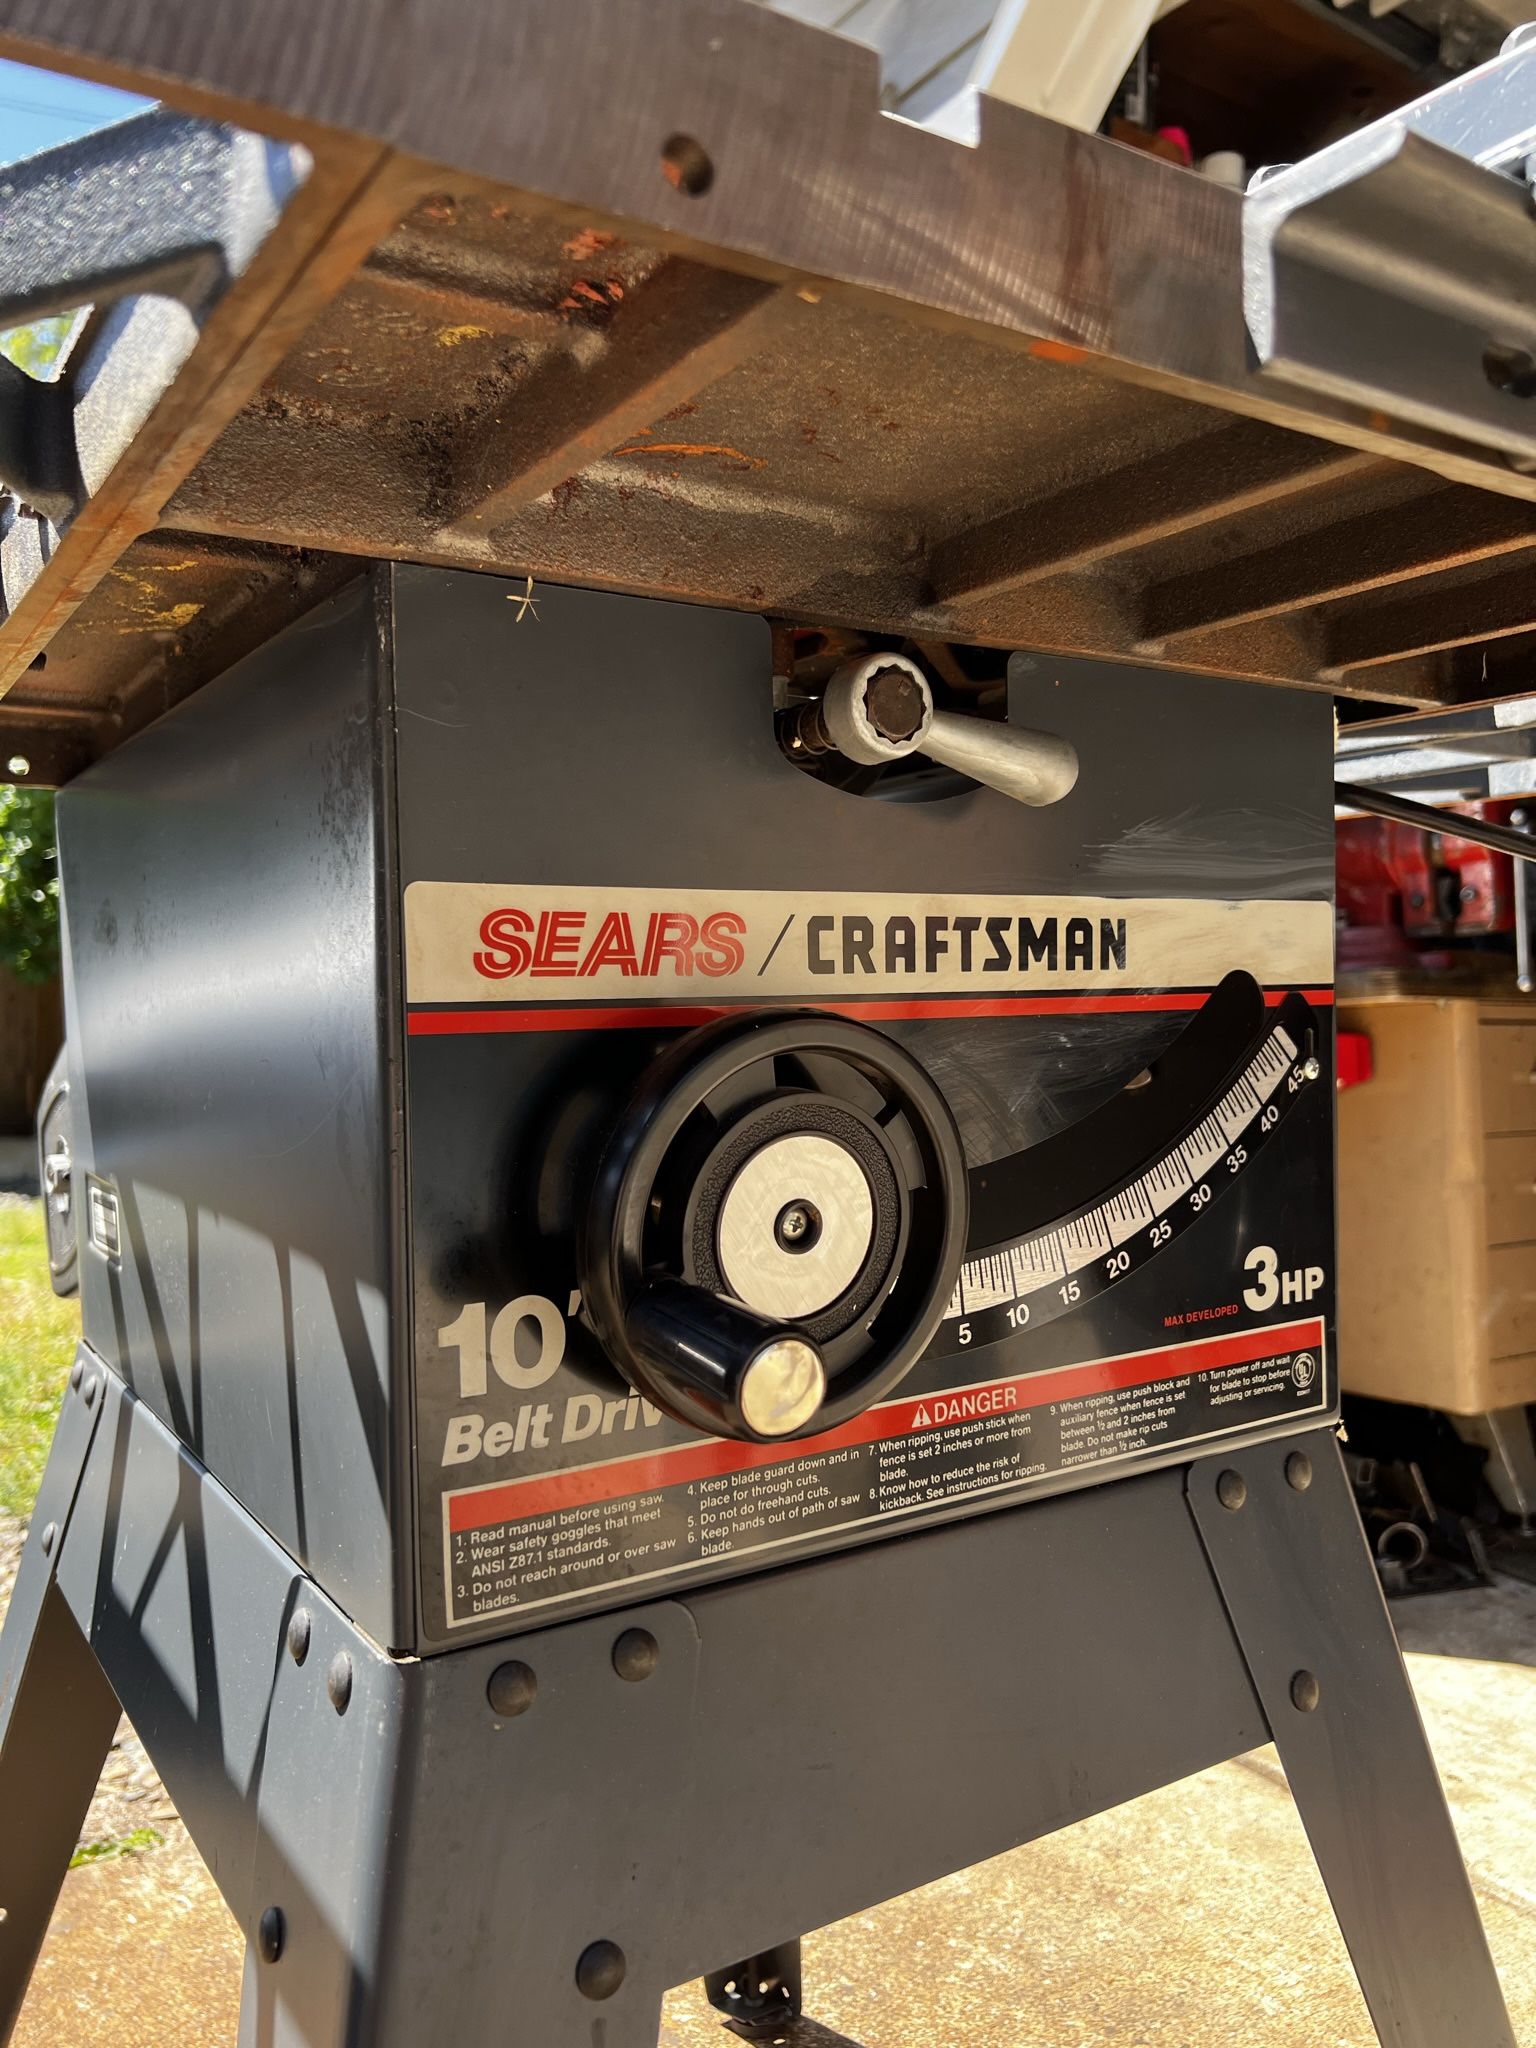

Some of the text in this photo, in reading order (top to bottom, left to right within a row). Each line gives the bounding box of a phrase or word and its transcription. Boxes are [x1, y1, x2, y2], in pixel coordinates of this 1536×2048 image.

[473, 908, 747, 980] SEARS
[807, 916, 1127, 974] CRAFTSMAN
[958, 1066, 1305, 1345] 5 10 15 20 25 30 35 40 45
[1243, 1246, 1324, 1312] 3 HP
[1164, 1304, 1238, 1327] MAX DEVELOPED
[1198, 1356, 1290, 1382] 10. Turn power off and wait
[1210, 1368, 1290, 1393] for blade to stop before
[934, 1386, 1017, 1422] DANGER
[1050, 1376, 1190, 1416] 9. When ripping, use push block and
[1060, 1391, 1186, 1426] auxiliary fence when fence is set
[1210, 1392, 1242, 1406] adjusting
[1244, 1388, 1252, 1397] or
[1254, 1382, 1285, 1395] servicing.
[441, 1386, 663, 1467] Belt Driv
[868, 1412, 1031, 1456] 7. When ripping, use push stick when
[1060, 1426, 1095, 1440] between
[1106, 1418, 1122, 1428] and
[1124, 1416, 1129, 1425] 2
[1130, 1410, 1156, 1423] inches
[1158, 1406, 1176, 1417] from
[1061, 1421, 1168, 1452] blade. Do not make rip cuts
[879, 1426, 1031, 1467] fence is set 2 inches or more from
[1062, 1451, 1097, 1466] narrower
[1100, 1444, 1117, 1456] than
[1129, 1438, 1146, 1449] inch.
[688, 1449, 859, 1495] 4. Keep blade guard down and in
[869, 1453, 1021, 1499] 8. Know how to reduce the risk of
[879, 1467, 908, 1482] blade.
[879, 1462, 1047, 1511] kickback. See instructions for ripping.
[688, 1487, 831, 1527] 5. Do not do freehand cuts.
[700, 1474, 820, 1511] place for through cuts.
[456, 1535, 467, 1547] 1.
[471, 1529, 504, 1544] Read
[509, 1516, 556, 1537] manual
[560, 1508, 600, 1526] before
[604, 1498, 636, 1515] using
[456, 1508, 661, 1564] 2. Wear safety goggles that meet
[688, 1494, 860, 1543] 6. Keep hands out of path of saw
[457, 1538, 677, 1598] 3. Do not reach around or over saw
[471, 1537, 611, 1578] ANSI Z87.1 standards.
[701, 1541, 734, 1556] blade.
[473, 1593, 519, 1612] blades.
